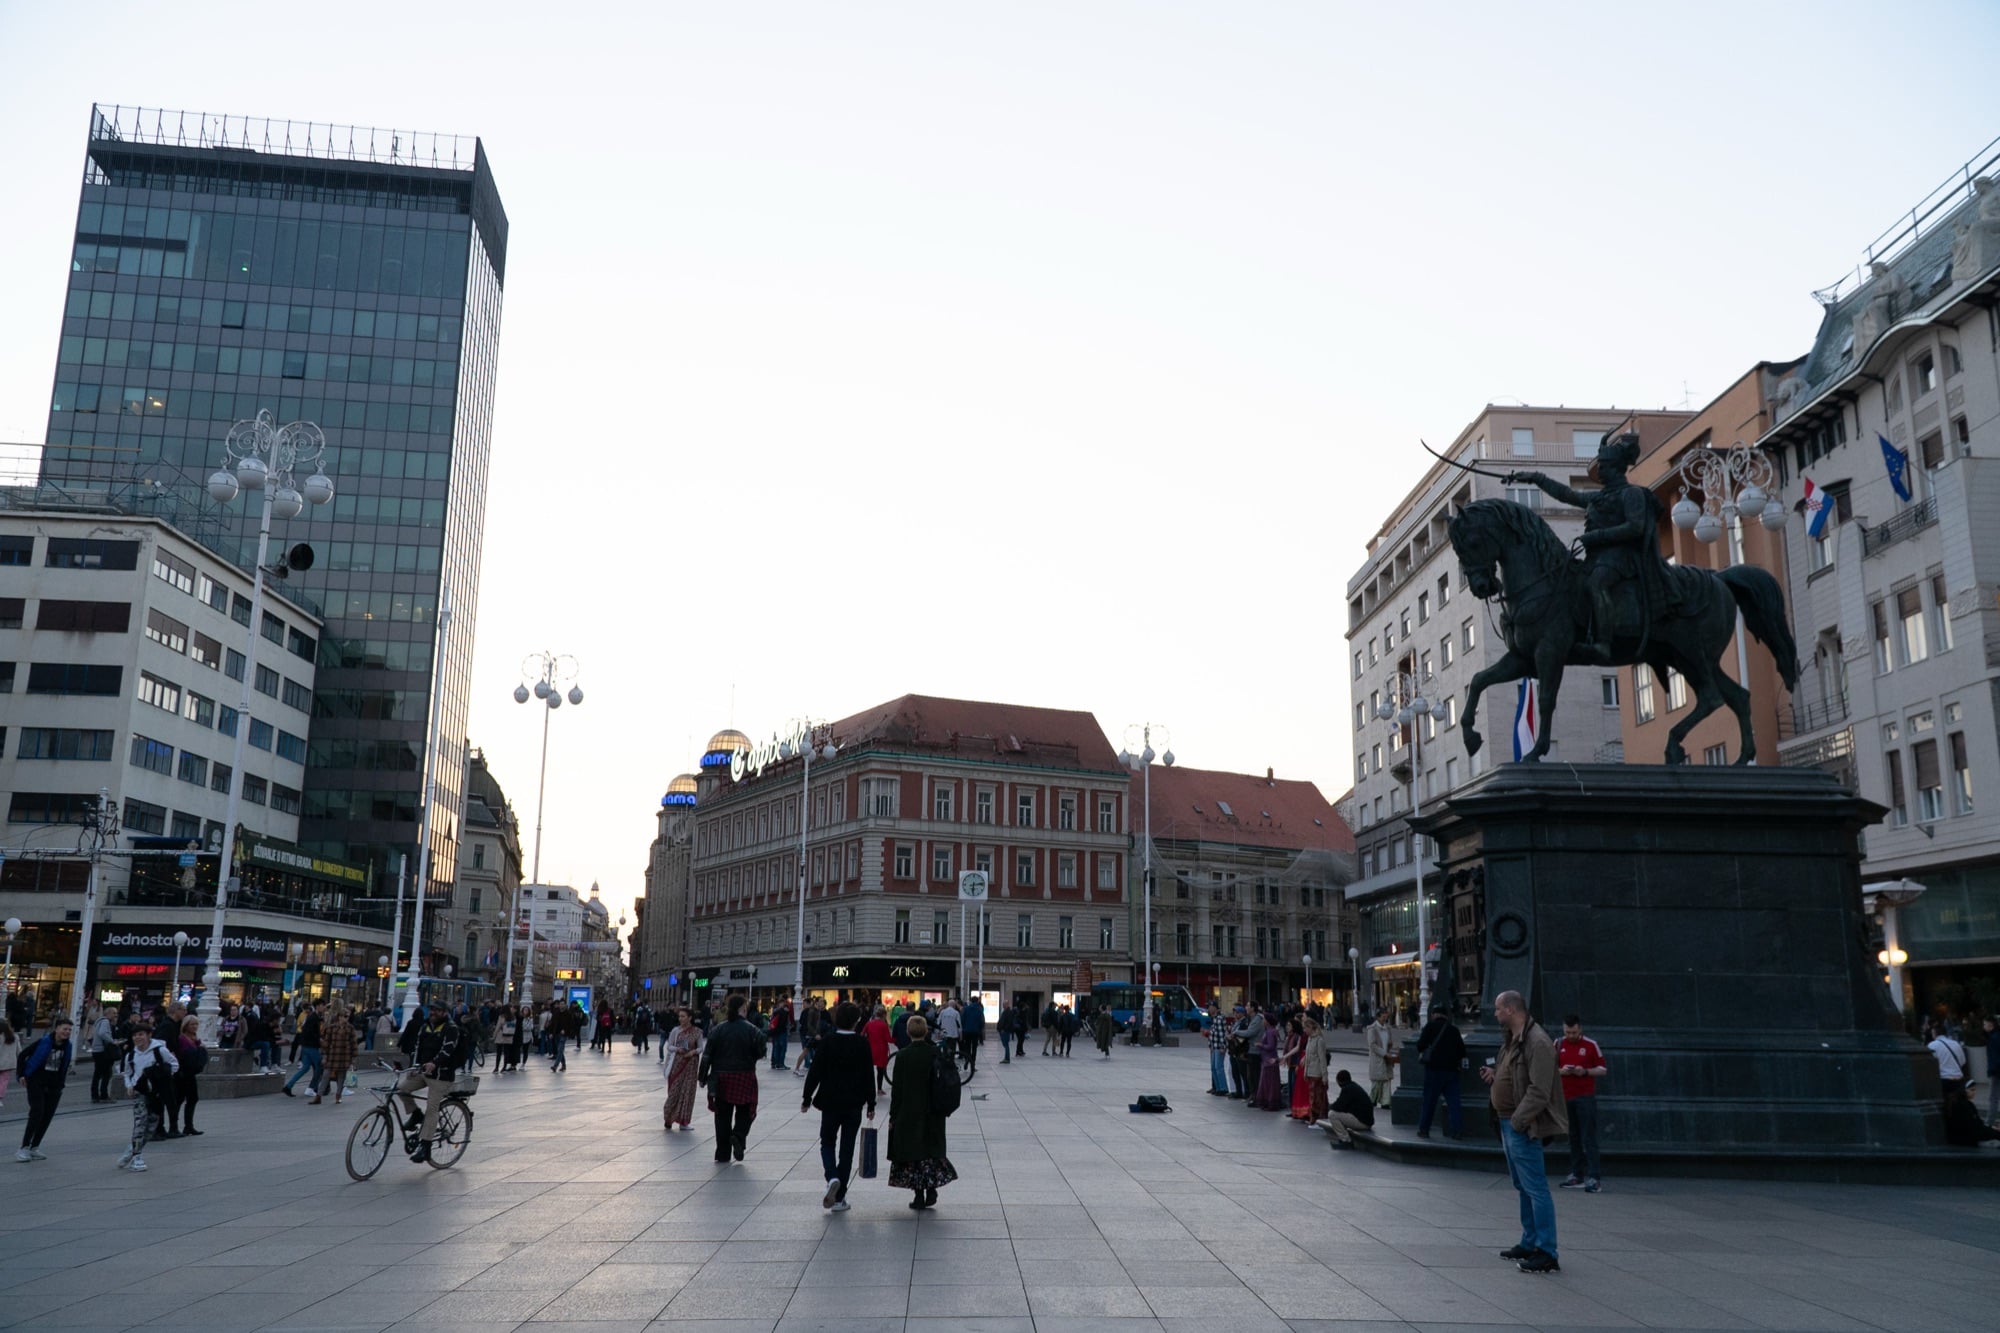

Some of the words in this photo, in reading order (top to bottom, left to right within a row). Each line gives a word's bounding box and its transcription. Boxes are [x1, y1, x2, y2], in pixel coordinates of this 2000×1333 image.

[103, 932, 201, 947] Jednostano
[890, 965, 926, 977] ZAKS
[1029, 967, 1073, 975] HOLDIN
